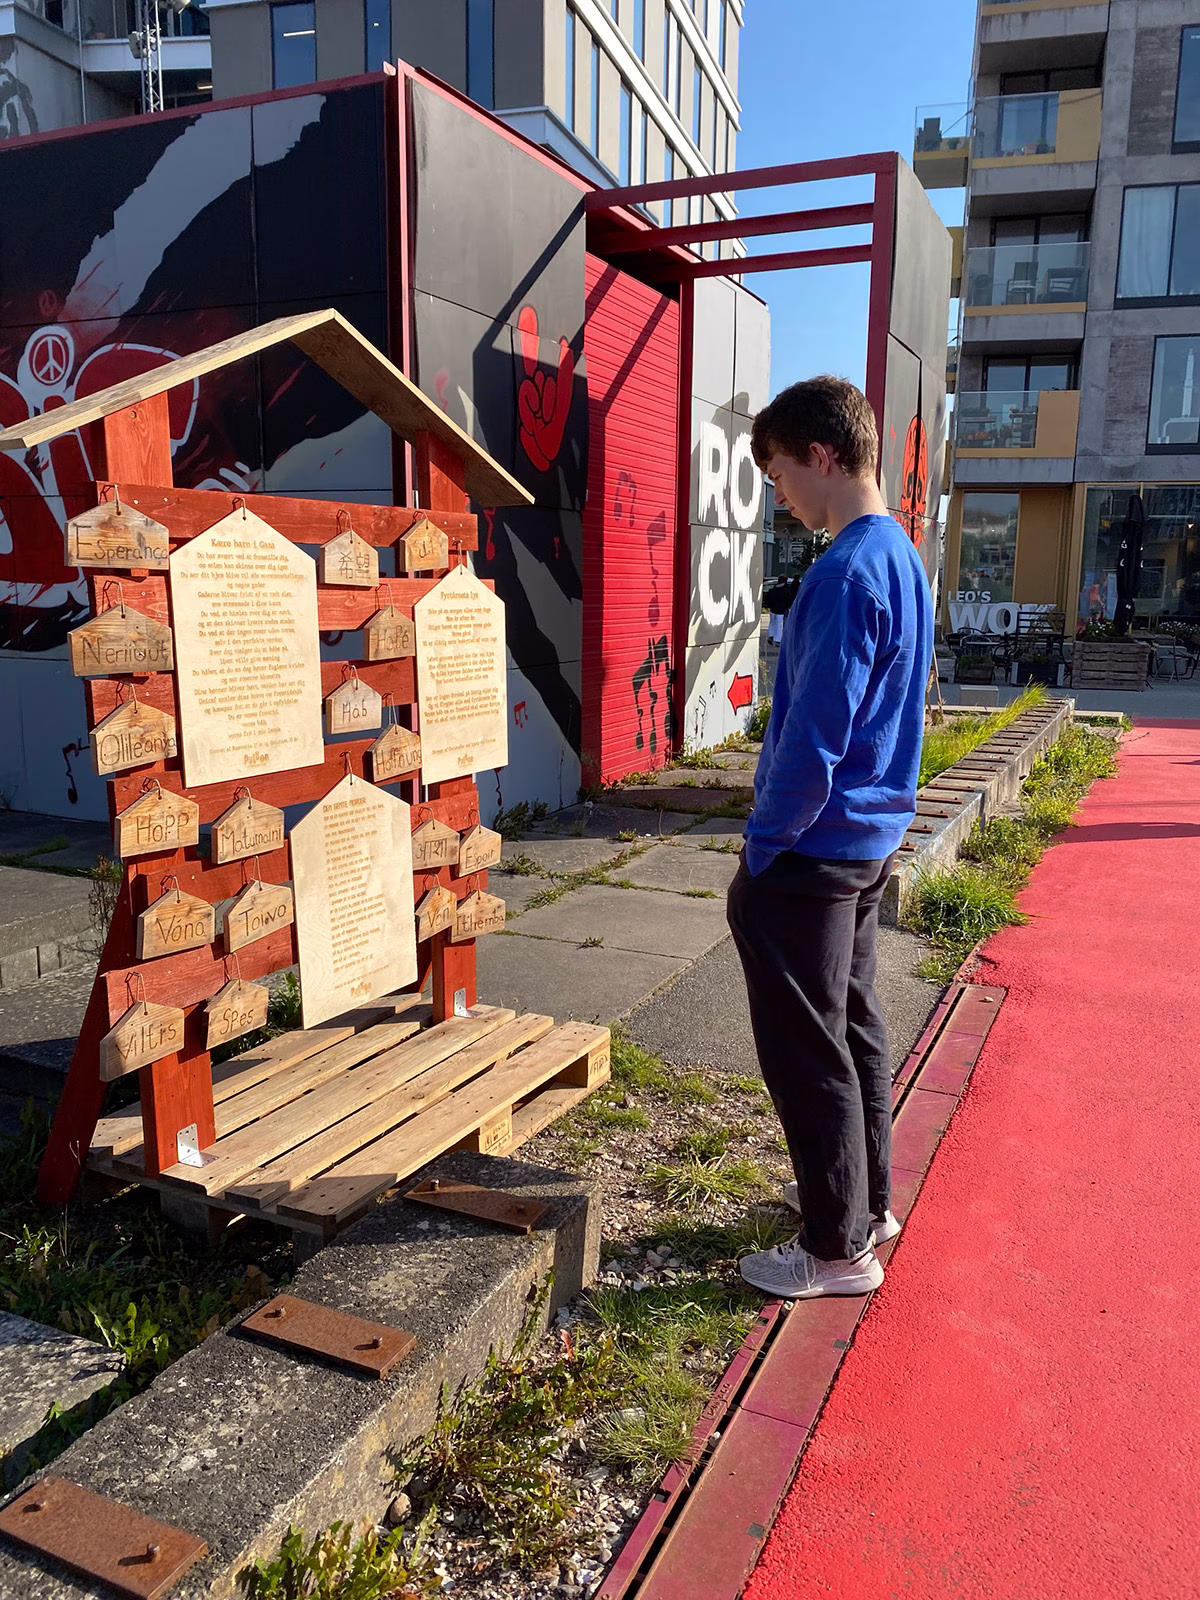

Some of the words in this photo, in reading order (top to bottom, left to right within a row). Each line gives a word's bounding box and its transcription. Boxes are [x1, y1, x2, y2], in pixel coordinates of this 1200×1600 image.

[234, 539, 250, 549] barn
[253, 541, 257, 550] i
[948, 590, 992, 602] LEO'S
